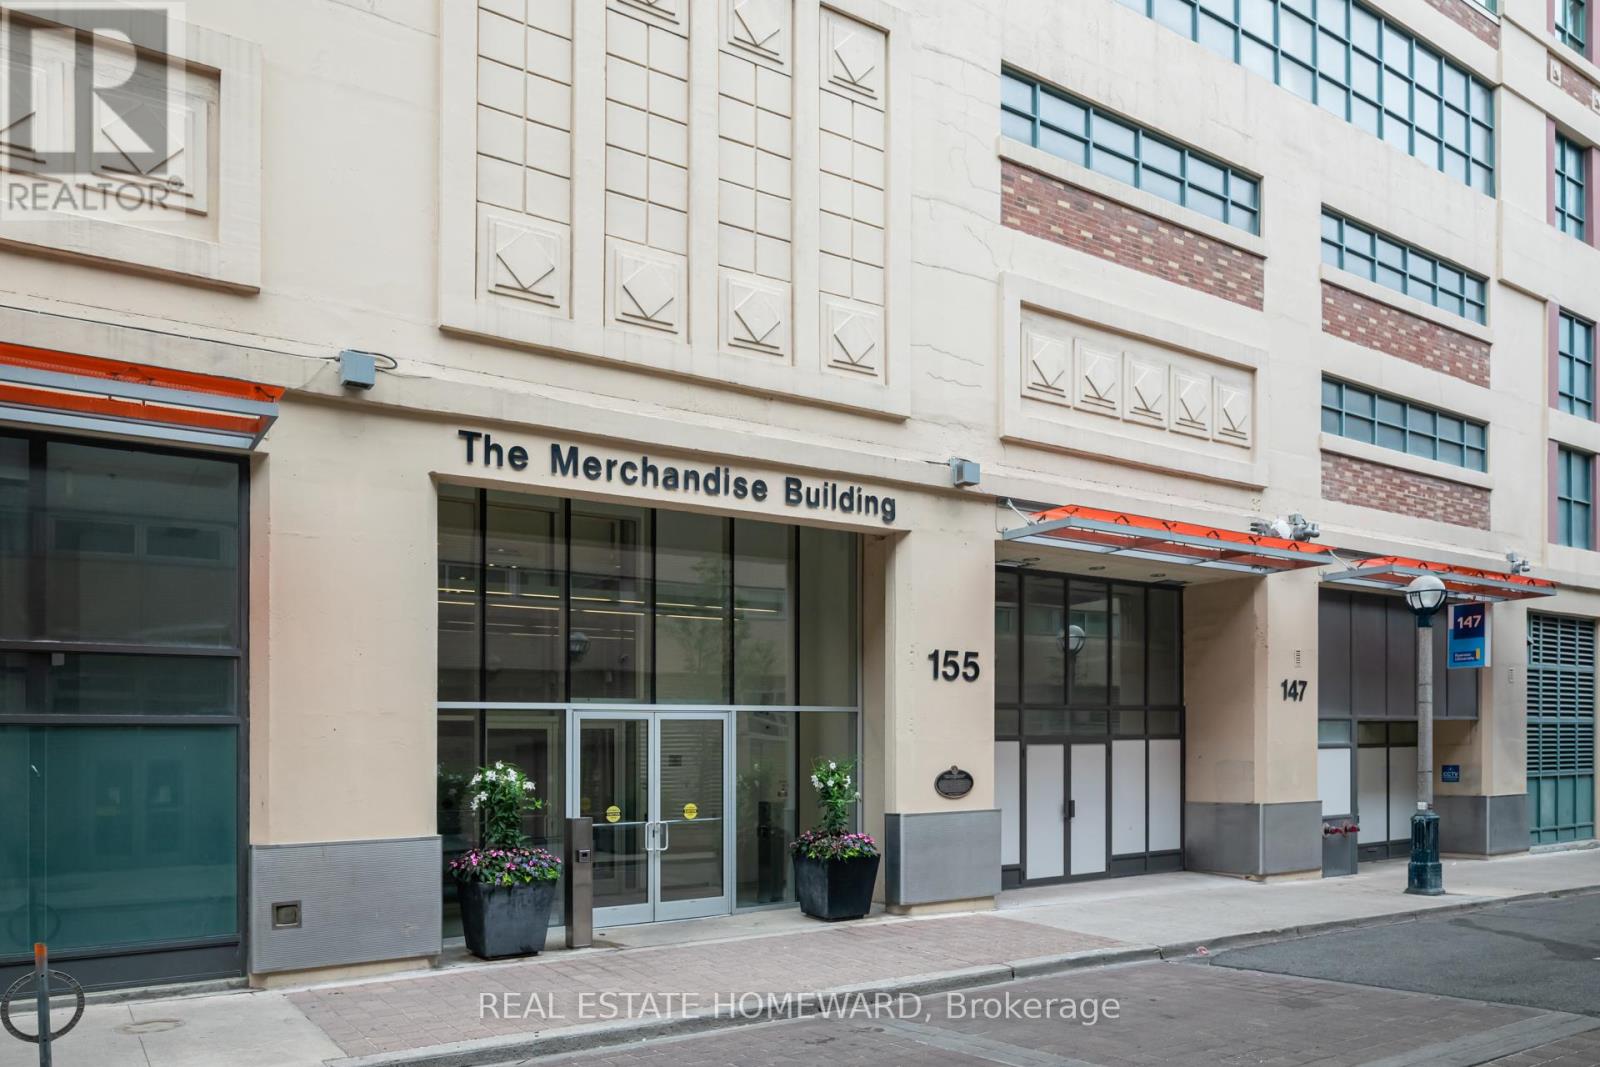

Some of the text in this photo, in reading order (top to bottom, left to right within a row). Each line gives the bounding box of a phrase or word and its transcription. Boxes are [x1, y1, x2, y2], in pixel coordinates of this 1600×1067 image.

[458, 429, 897, 523] The Merchandise Building
[1457, 615, 1482, 629] 147
[928, 649, 980, 682] 155
[1281, 679, 1308, 702] 147
